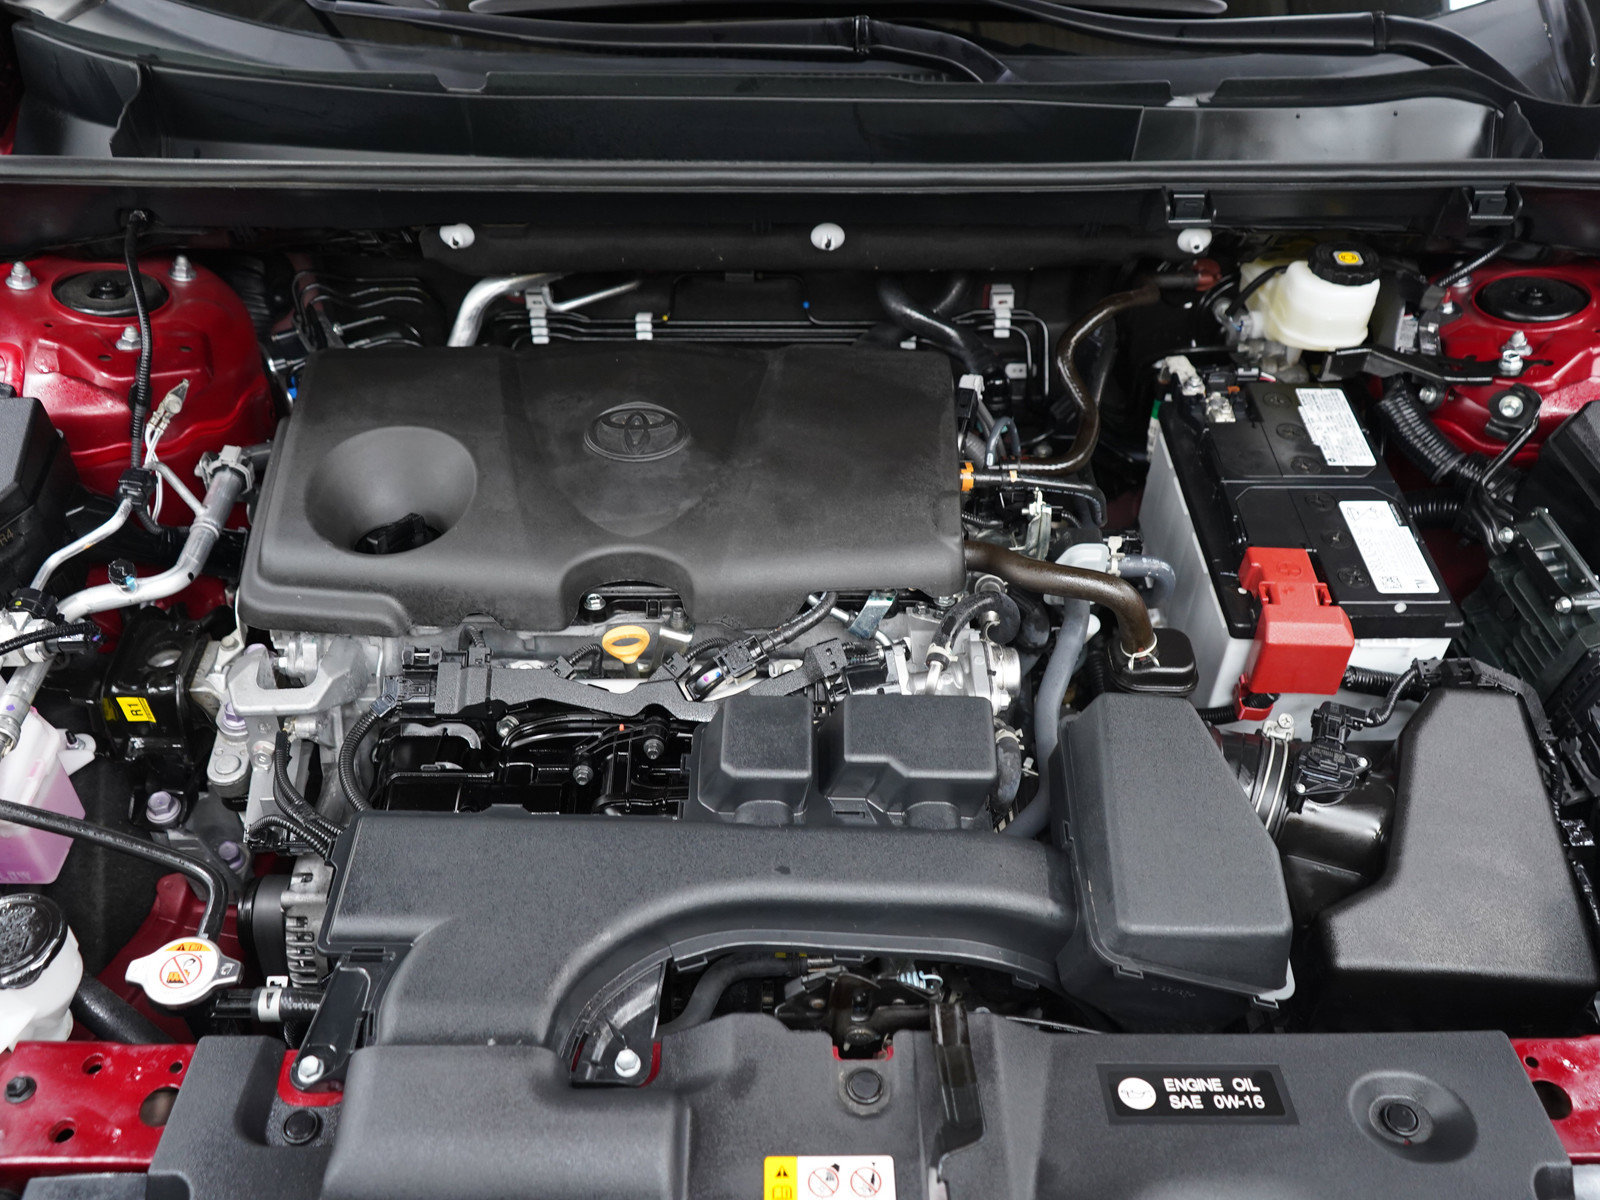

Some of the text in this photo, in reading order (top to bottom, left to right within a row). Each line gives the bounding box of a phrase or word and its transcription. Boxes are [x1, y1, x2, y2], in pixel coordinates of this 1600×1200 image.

[1163, 1077, 1261, 1092] ENGINE OIL
[1168, 1094, 1266, 1110] SAE 0W-16
